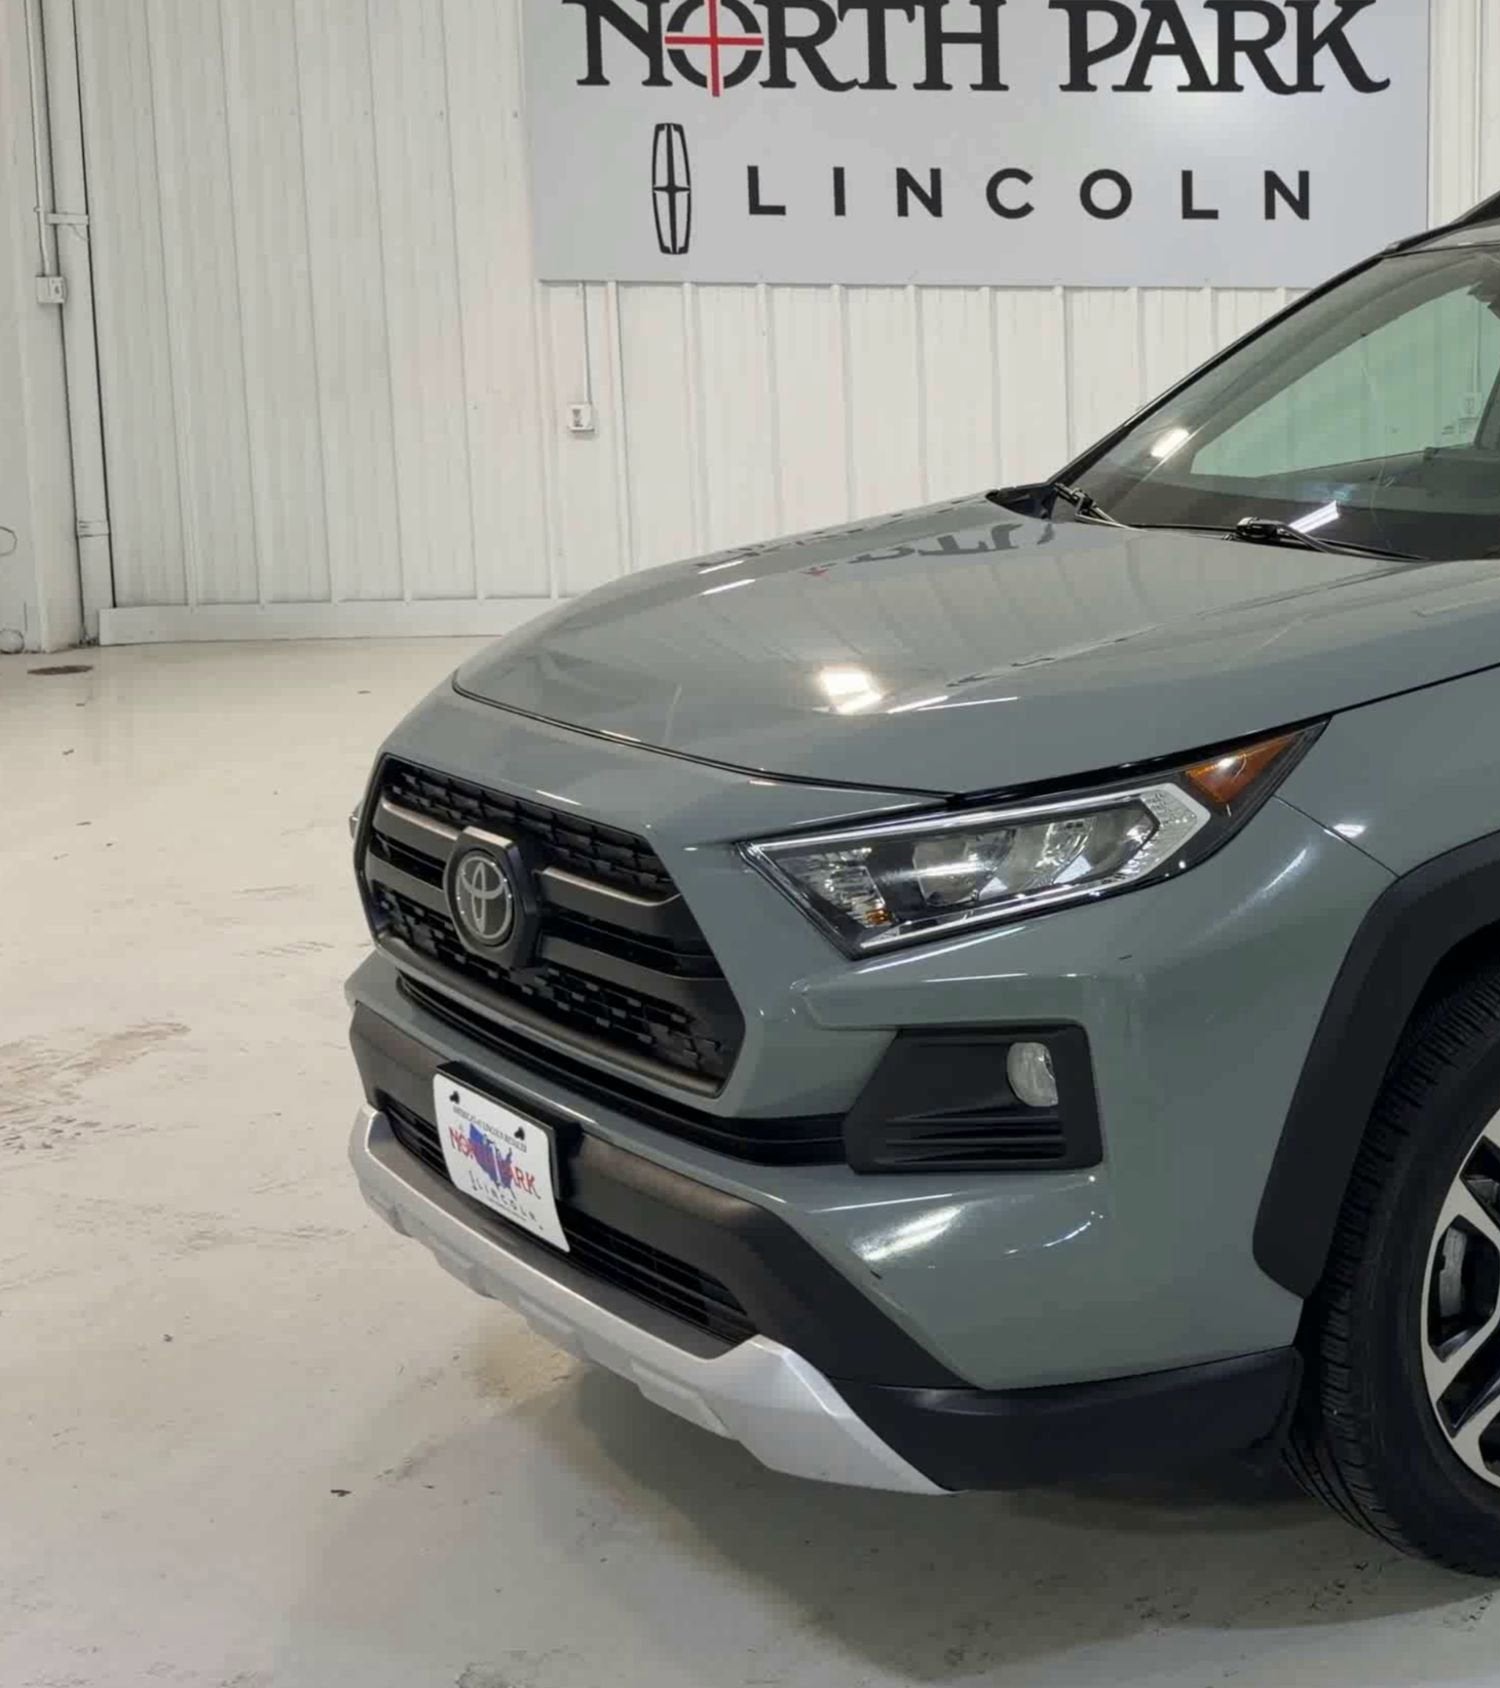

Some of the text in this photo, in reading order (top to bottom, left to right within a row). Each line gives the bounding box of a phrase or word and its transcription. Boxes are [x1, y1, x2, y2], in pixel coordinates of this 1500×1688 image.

[562, 0, 1390, 95] NORTH PARK
[747, 165, 1310, 221] LINCOLN
